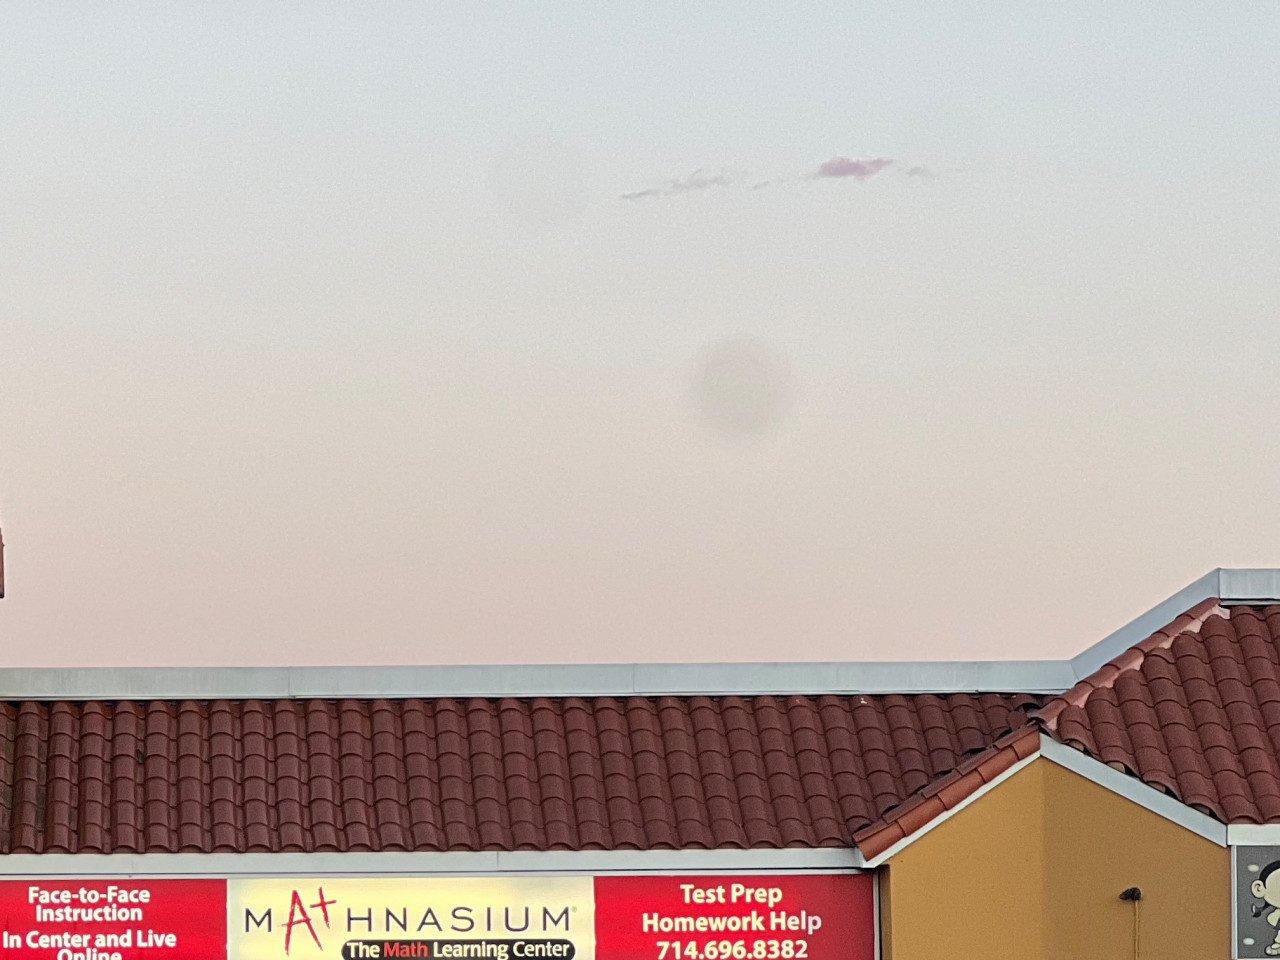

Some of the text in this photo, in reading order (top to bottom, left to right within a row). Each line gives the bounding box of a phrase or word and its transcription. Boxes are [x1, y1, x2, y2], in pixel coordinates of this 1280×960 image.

[28, 886, 151, 903] Face-to-Face
[680, 883, 783, 907] Test Prep
[36, 904, 143, 921] Instruction
[642, 910, 822, 935] Homework Help
[2, 929, 177, 948] In Center and Live
[346, 941, 570, 960] The Math Learning Center
[656, 939, 809, 960] 714.696.8382
